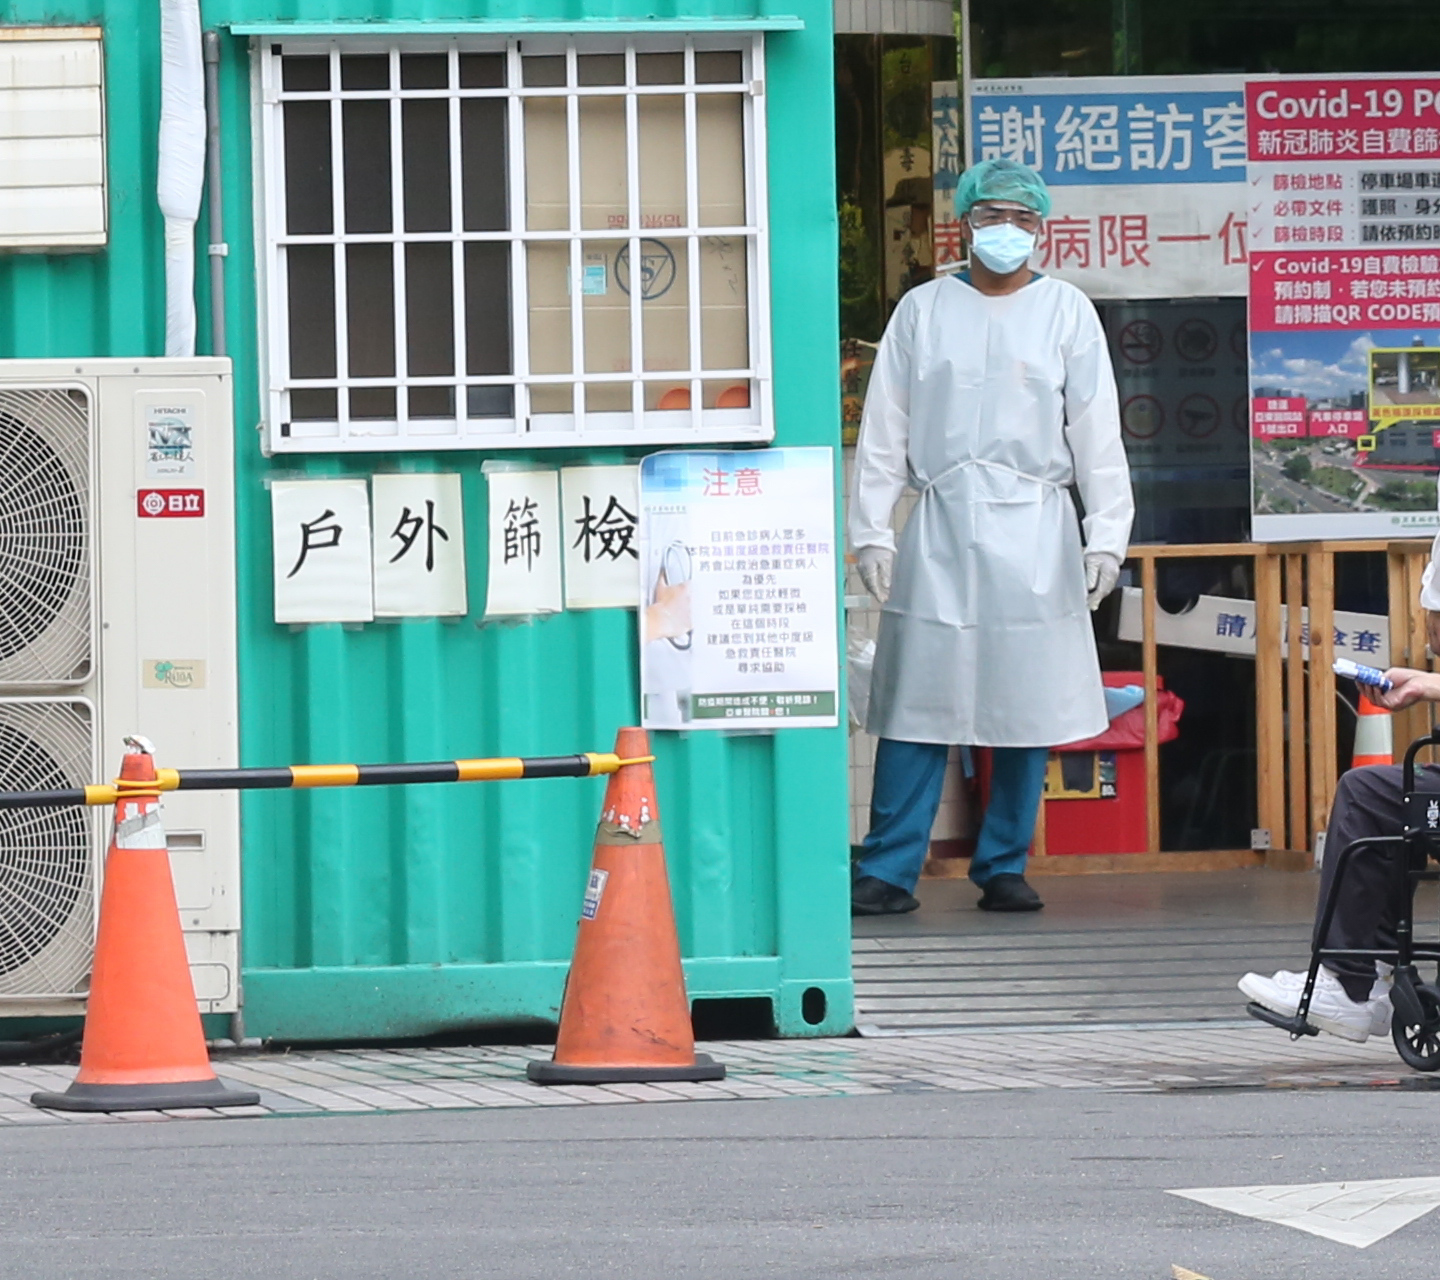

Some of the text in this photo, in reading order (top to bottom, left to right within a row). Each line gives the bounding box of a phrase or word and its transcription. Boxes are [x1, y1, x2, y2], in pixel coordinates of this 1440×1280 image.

[1256, 89, 1404, 119] Covid-19
[978, 101, 1247, 172] 謝絕訪客
[702, 467, 763, 496] 注意
[168, 493, 200, 512] 日立
[287, 495, 639, 578] 戶外篩檢
